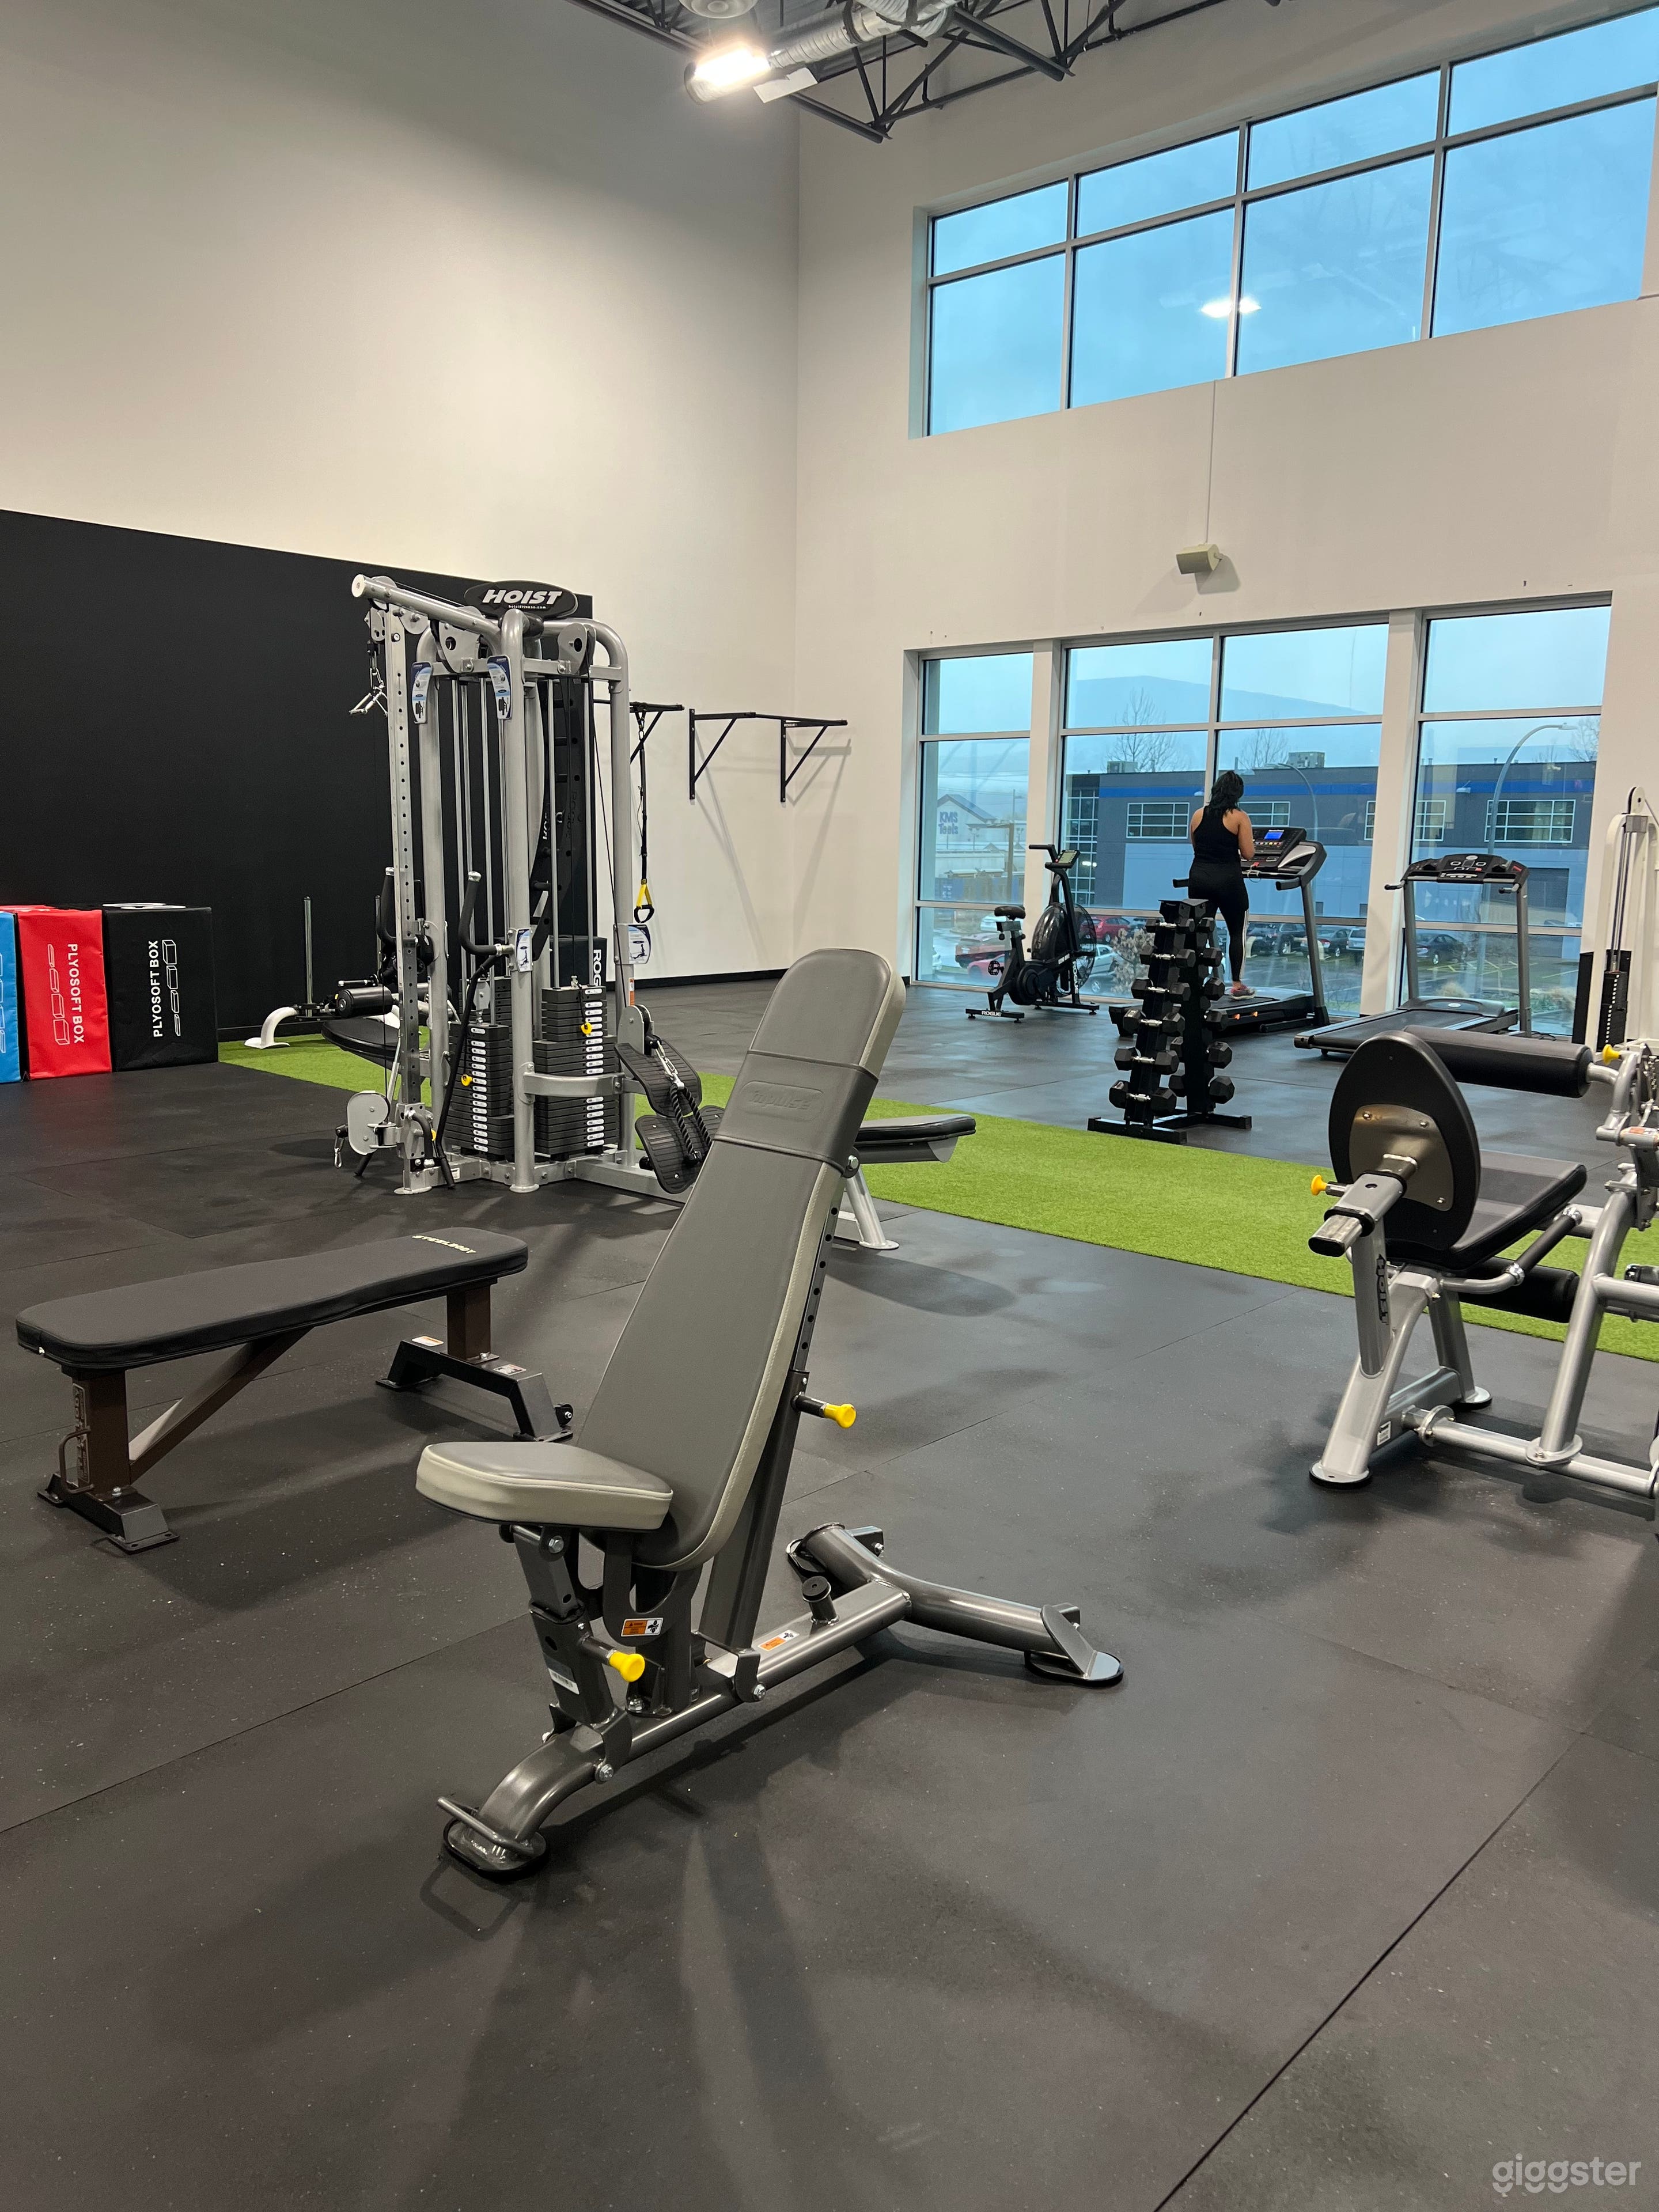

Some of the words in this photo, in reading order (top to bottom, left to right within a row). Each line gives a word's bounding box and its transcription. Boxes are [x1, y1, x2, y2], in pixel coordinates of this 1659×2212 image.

[482, 589, 563, 605] HOIST
[938, 823, 959, 835] Tools
[940, 812, 958, 823] KMS
[148, 940, 160, 968] BOX
[67, 944, 82, 1013] PLYOSOFT
[150, 971, 163, 1037] PLYOSOFT
[72, 1016, 85, 1044] BOX
[411, 1235, 476, 1253] STEELBODY
